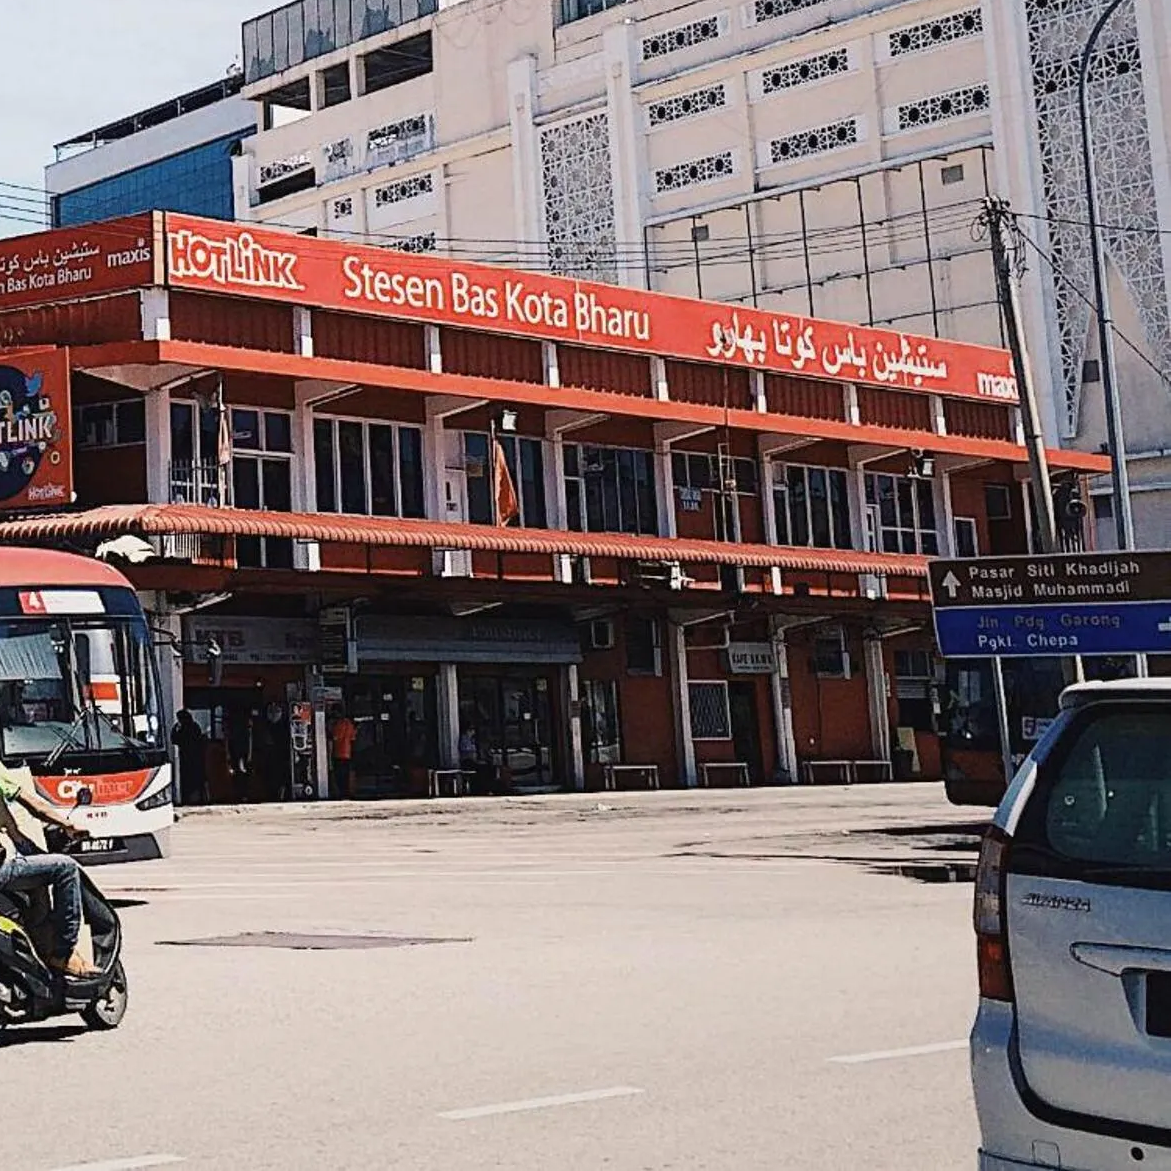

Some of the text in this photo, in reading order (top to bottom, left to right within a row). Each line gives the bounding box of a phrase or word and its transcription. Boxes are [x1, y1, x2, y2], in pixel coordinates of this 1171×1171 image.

[107, 237, 151, 268] maxis
[7, 277, 27, 293] Bas
[29, 273, 55, 289] Kota
[57, 267, 91, 284] Bharu
[342, 255, 650, 340] Stesen Bas Kota Bharu
[968, 560, 1140, 579] Pasar Siti Khadijah
[972, 580, 1130, 600] Masjid Muhammadi
[1061, 613, 1120, 628] Garong
[1027, 633, 1078, 648] Chepa
